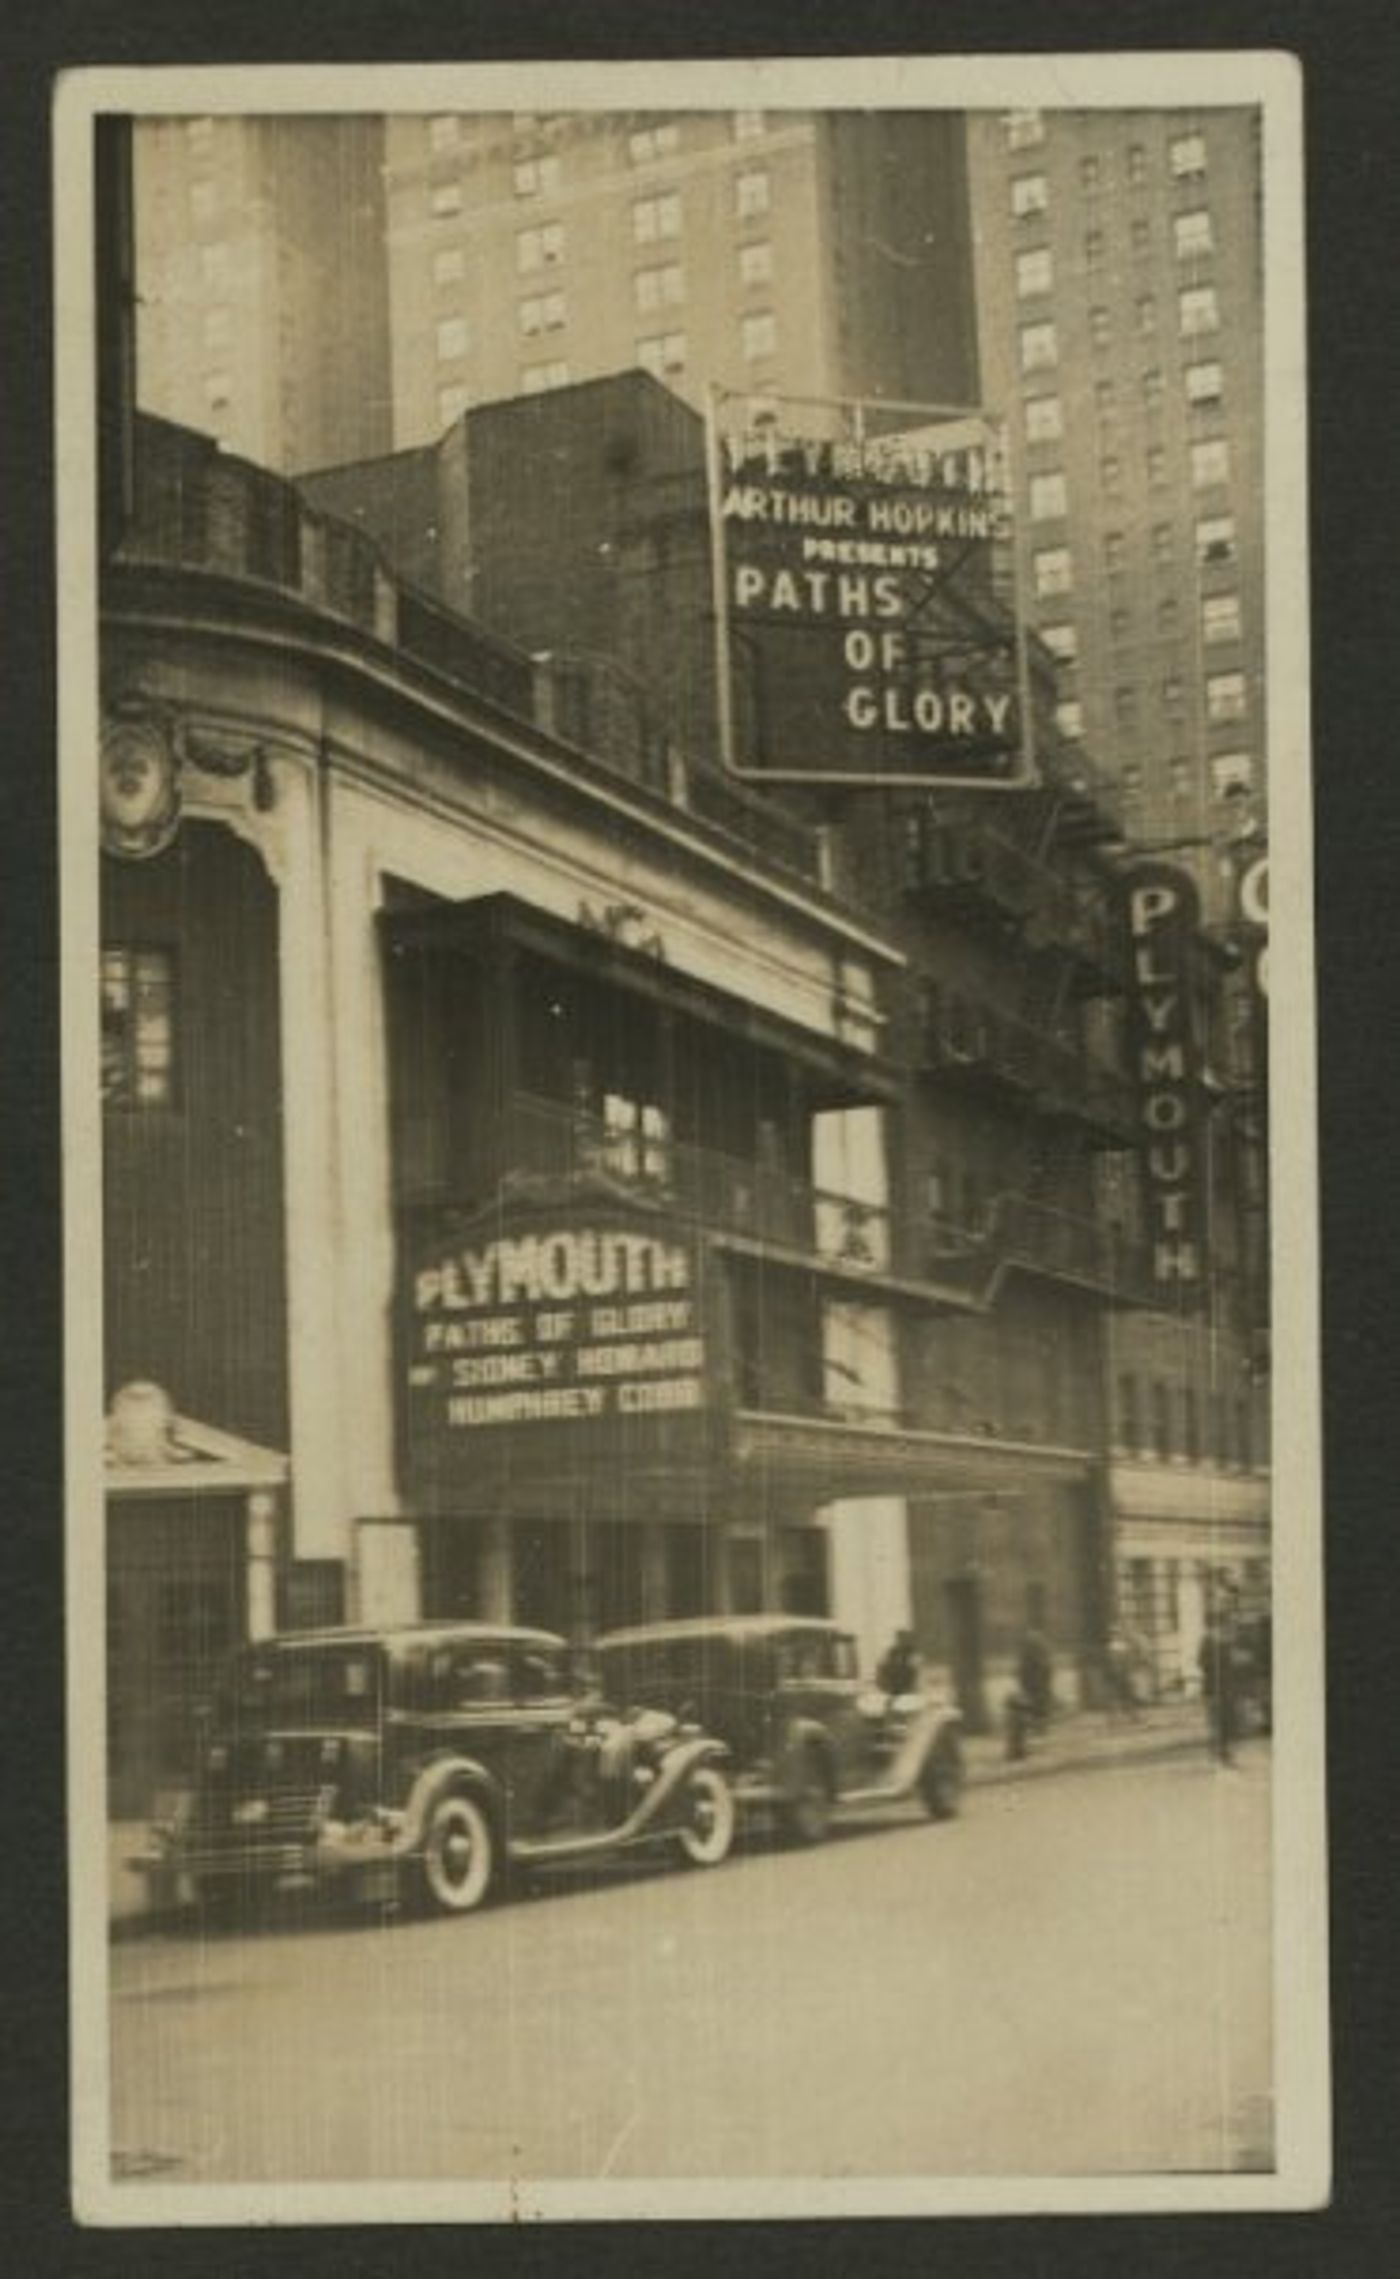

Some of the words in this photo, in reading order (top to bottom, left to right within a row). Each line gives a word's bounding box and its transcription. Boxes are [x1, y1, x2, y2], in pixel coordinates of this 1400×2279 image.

[722, 486, 856, 527] ARTHUR
[868, 500, 1011, 539] HOPKINS
[803, 537, 938, 570] PRESENTS
[734, 566, 902, 617] PATHS
[844, 629, 905, 671] OF
[844, 686, 1010, 734] GLORY
[1131, 887, 1198, 1281] PLYMOUTH
[415, 1231, 689, 1311] PLYMOUTH
[425, 1316, 526, 1351] PATHS
[536, 1312, 576, 1342] OF
[453, 1352, 560, 1387] SIDNEY
